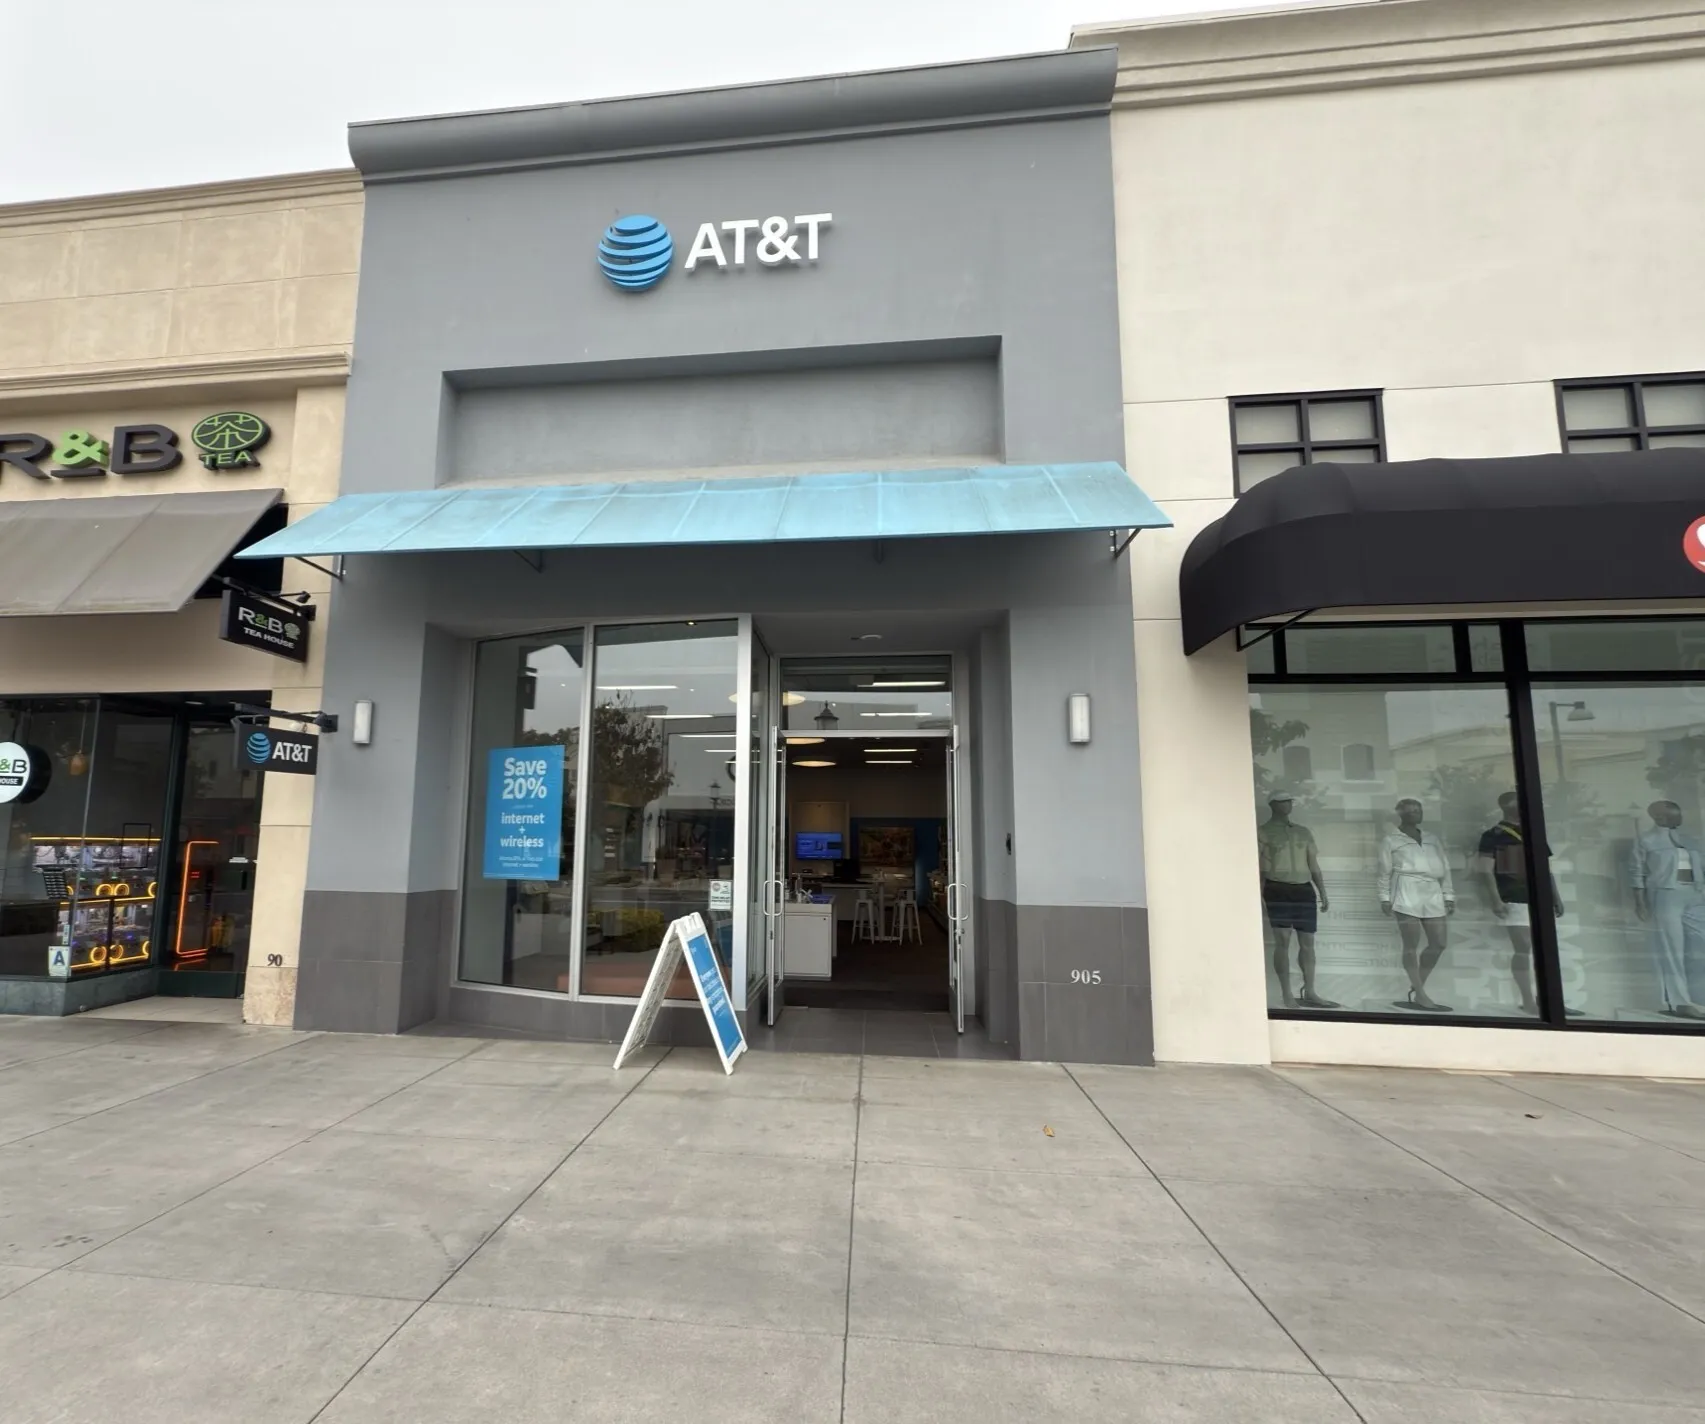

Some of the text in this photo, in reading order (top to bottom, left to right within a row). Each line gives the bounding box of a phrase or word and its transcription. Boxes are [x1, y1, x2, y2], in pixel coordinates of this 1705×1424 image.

[684, 213, 833, 272] AT&T
[0, 424, 183, 479] R&B
[200, 450, 253, 466] TEA
[238, 606, 284, 633] R&B
[244, 626, 295, 649] TEA HOUSE
[272, 741, 312, 762] AT&T
[0, 758, 27, 773] &B
[504, 757, 547, 777] Save
[502, 777, 548, 800] 20%
[501, 812, 545, 824] internet
[500, 835, 544, 848] wireless
[53, 950, 66, 967] A
[1070, 969, 1102, 985] 905
